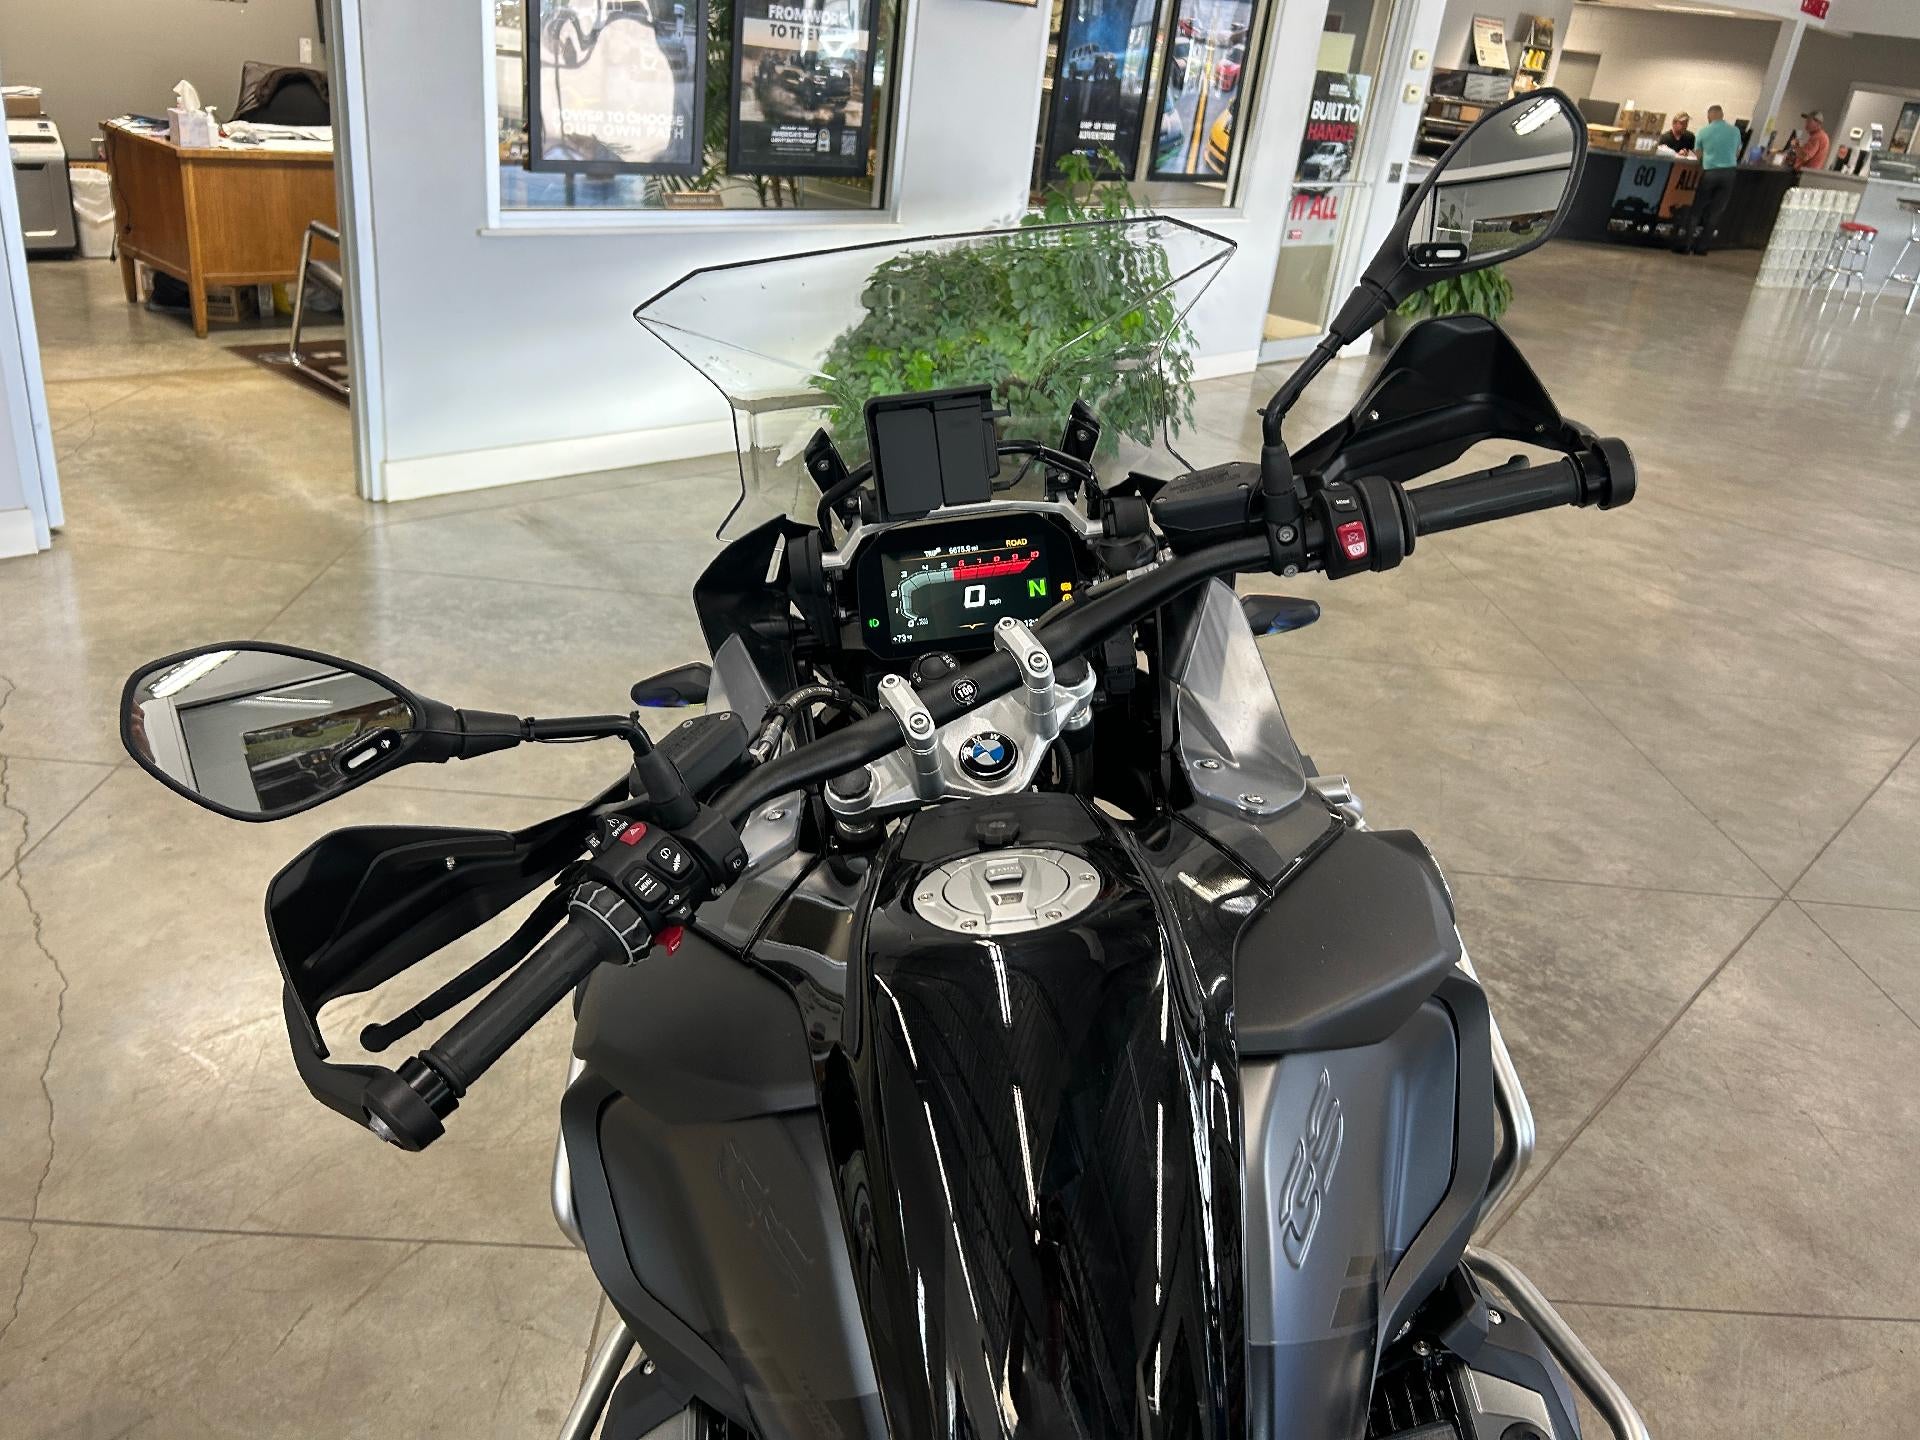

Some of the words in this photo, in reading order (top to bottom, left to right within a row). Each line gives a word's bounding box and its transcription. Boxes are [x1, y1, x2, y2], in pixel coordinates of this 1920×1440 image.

[768, 4, 810, 22] FROM
[770, 23, 787, 38] TO
[1311, 99, 1344, 121] BUILT
[1344, 103, 1360, 122] TO
[602, 123, 641, 137] OWN
[1307, 121, 1357, 142] HANDLE
[1634, 165, 1657, 188] GO
[1290, 194, 1310, 220] IT
[1308, 194, 1338, 220] ALL
[1005, 538, 1028, 548] ROAD
[963, 584, 986, 609] 0
[1028, 579, 1047, 597] N
[961, 732, 1001, 761] BMW
